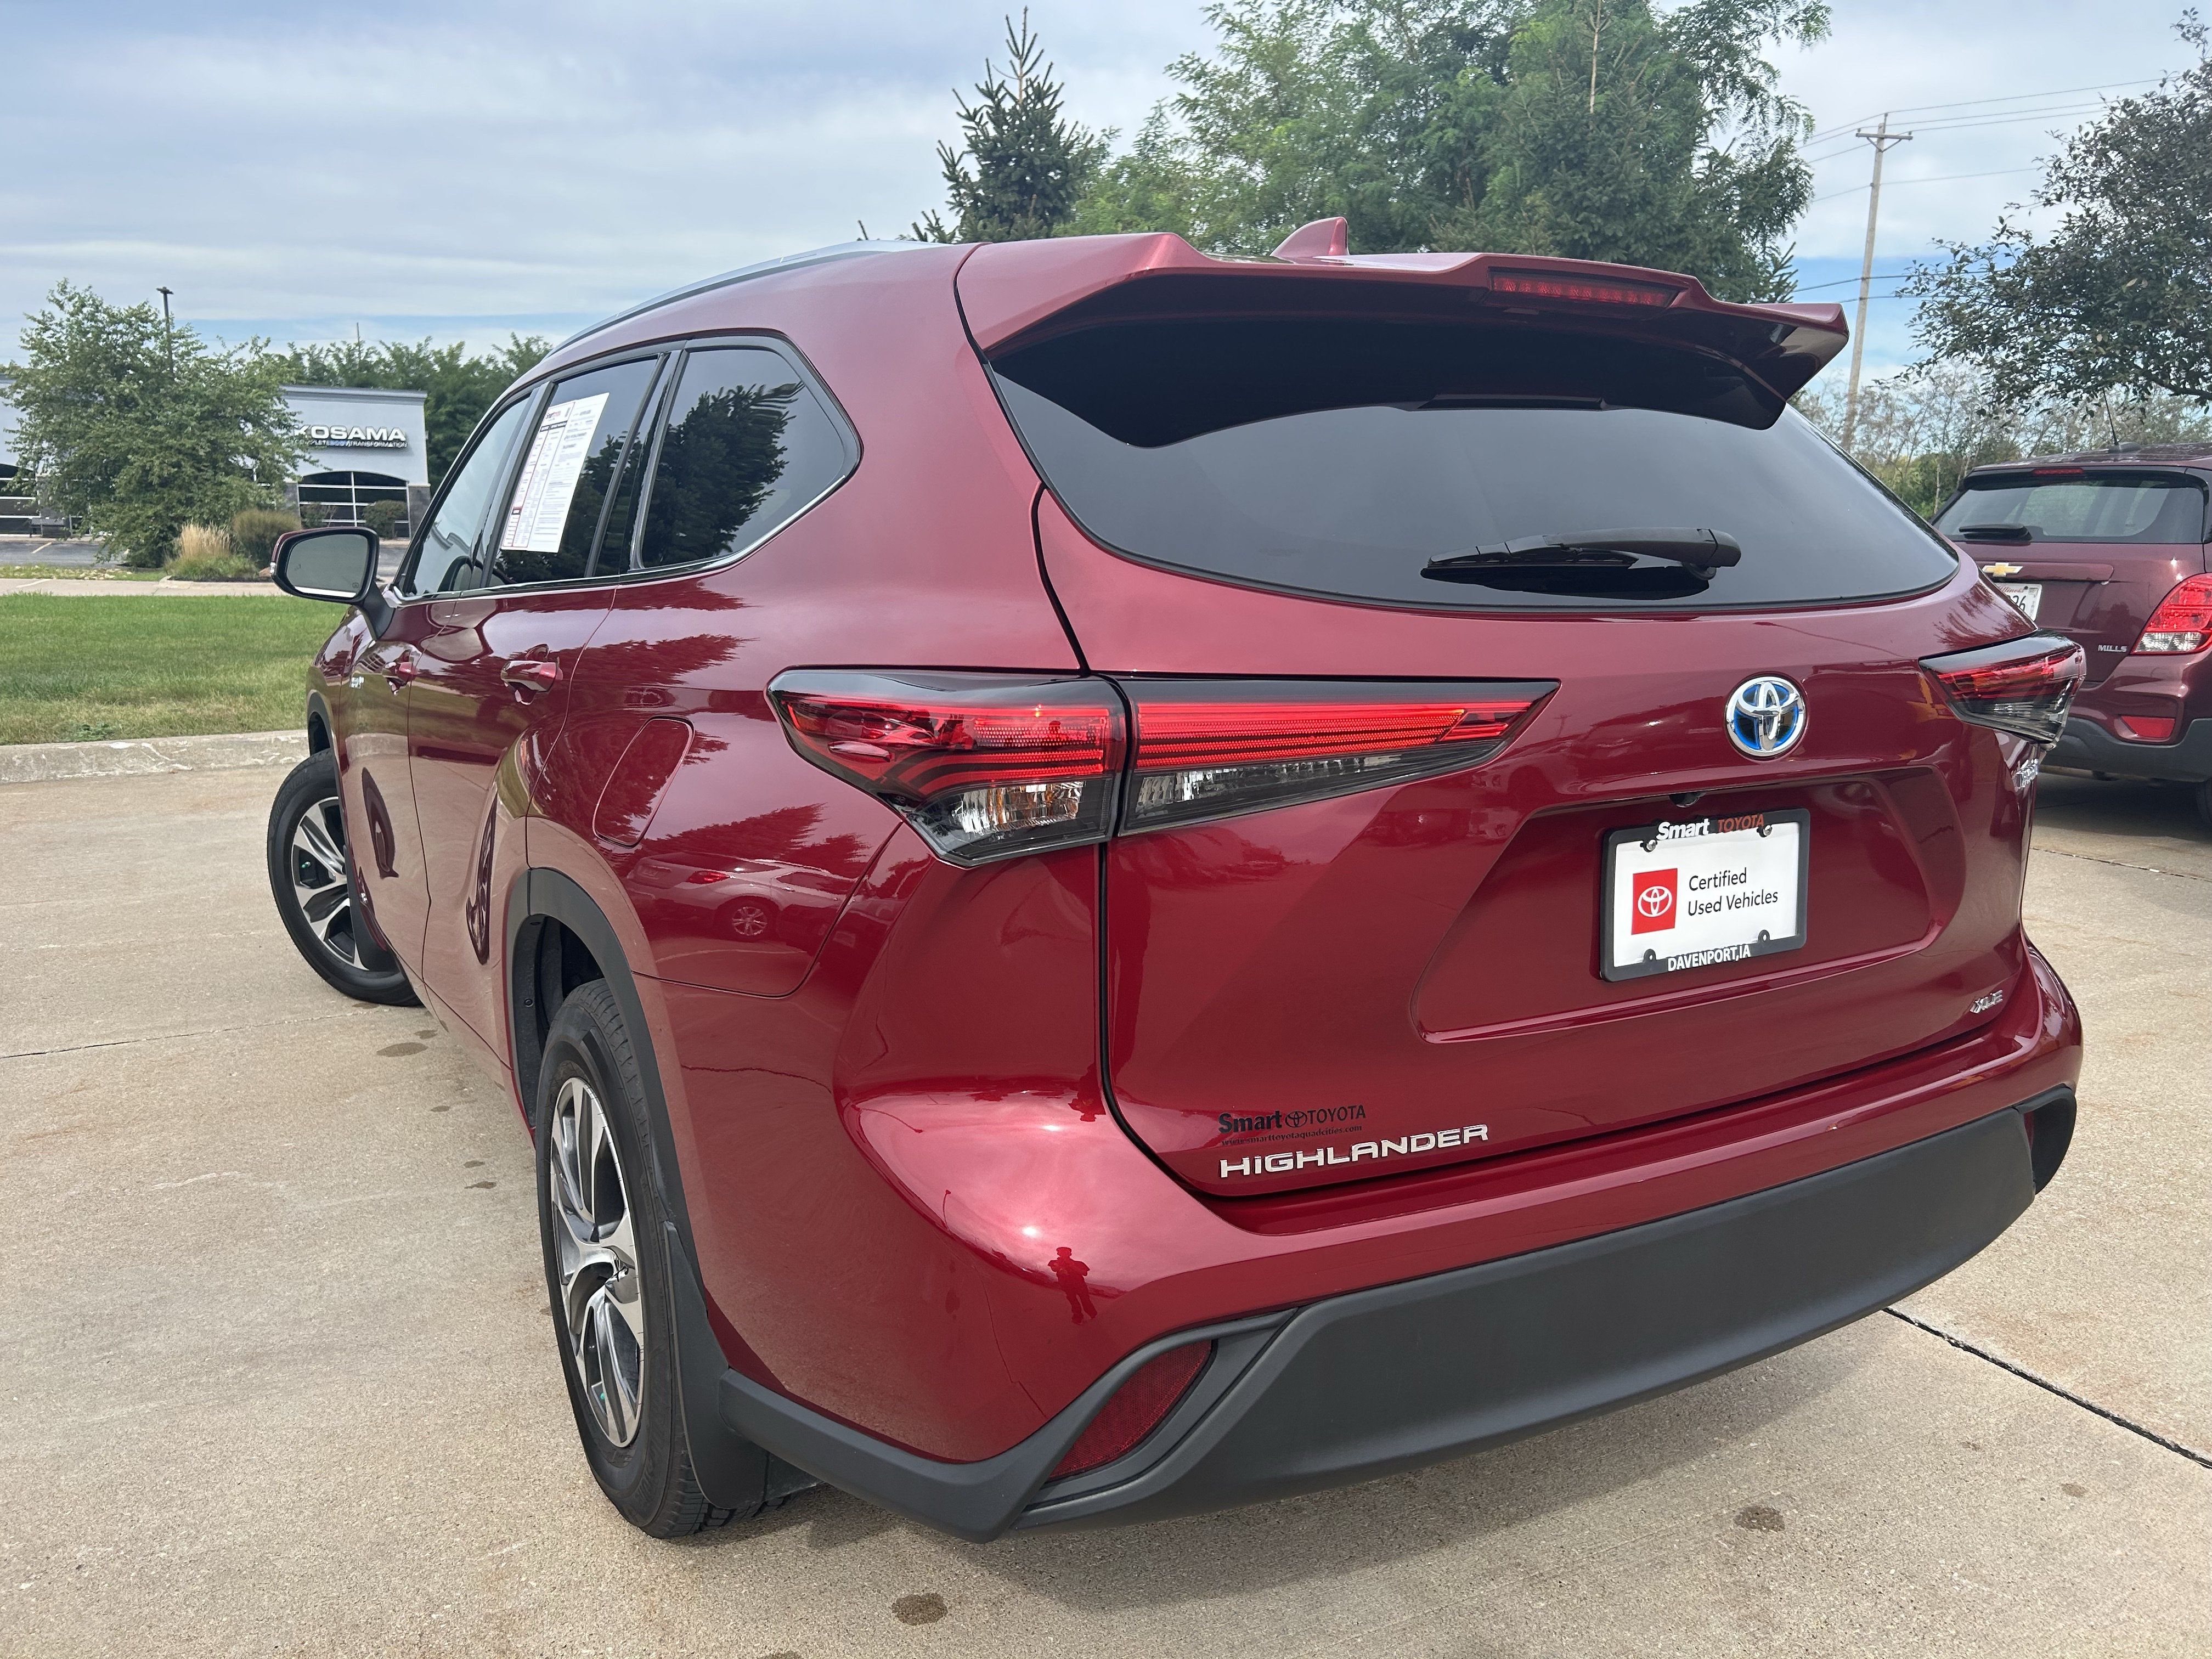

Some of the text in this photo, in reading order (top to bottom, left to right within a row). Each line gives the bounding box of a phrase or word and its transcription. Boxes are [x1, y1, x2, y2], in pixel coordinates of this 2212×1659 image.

[294, 425, 406, 441] KOSAMA
[1656, 814, 1764, 840] Smart TOYOTA
[1689, 867, 1747, 891] Certified
[1688, 889, 1778, 916] Used Vehicles
[1667, 944, 1751, 972] DAVENPORT,IA
[1218, 1105, 1365, 1133] Smart TOYOTA
[1222, 1125, 1362, 1146] www.smarttoyotaquadcities.com
[1220, 1124, 1489, 1178] HIGHLANDER
